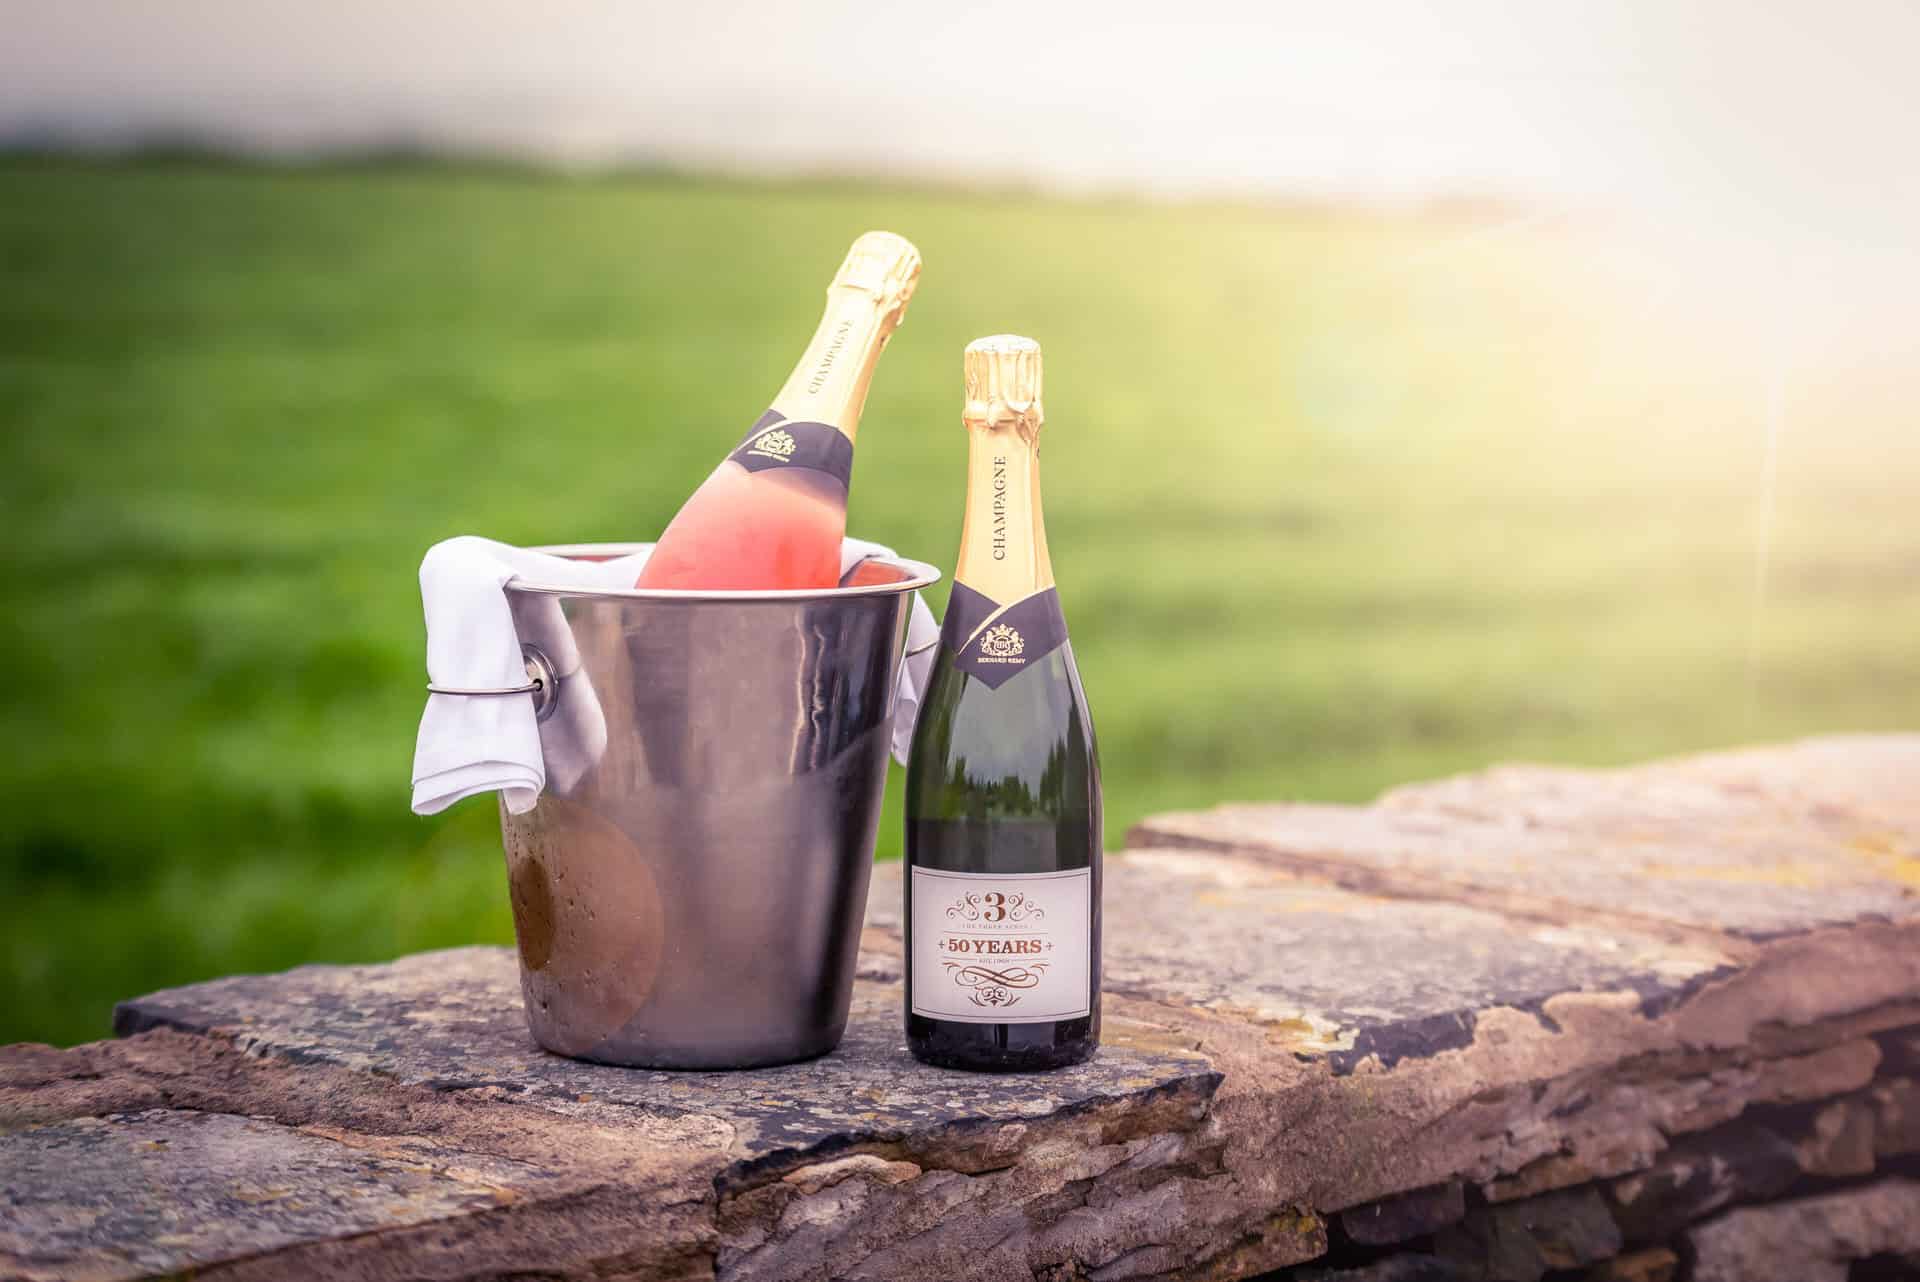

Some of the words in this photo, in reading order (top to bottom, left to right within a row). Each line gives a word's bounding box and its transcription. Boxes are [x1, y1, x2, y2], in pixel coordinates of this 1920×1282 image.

[808, 320, 854, 394] CHAMPAGNE
[993, 456, 1007, 561] CHAMPAGNE
[983, 892, 1006, 922] 3
[948, 939, 970, 953] 50
[971, 939, 1042, 954] YEARS
